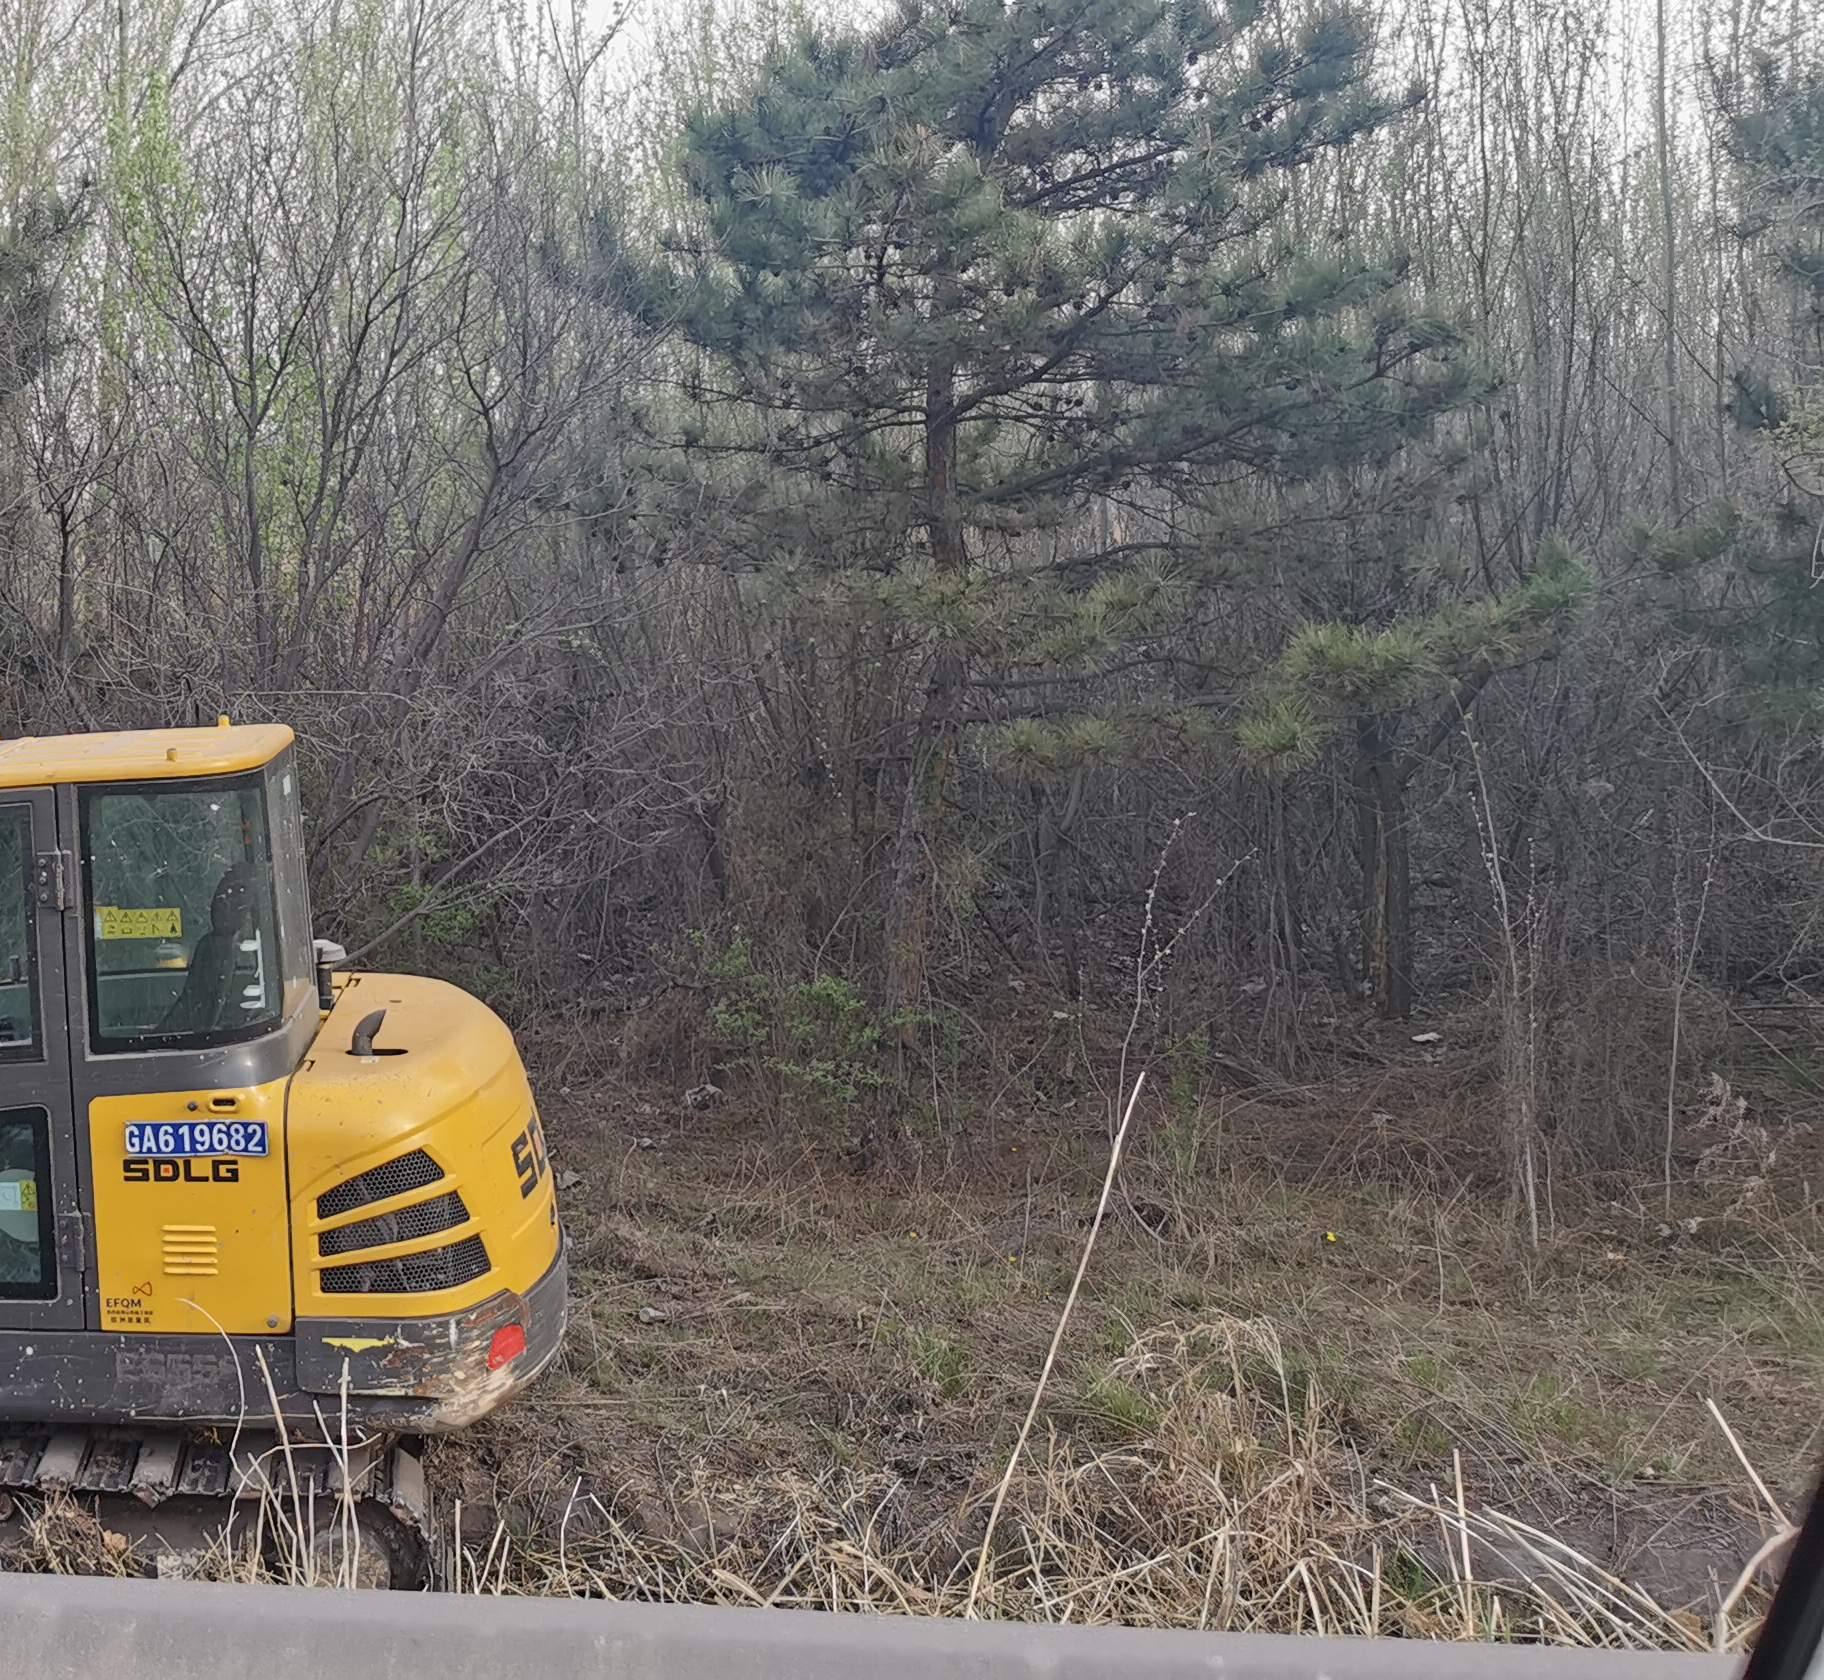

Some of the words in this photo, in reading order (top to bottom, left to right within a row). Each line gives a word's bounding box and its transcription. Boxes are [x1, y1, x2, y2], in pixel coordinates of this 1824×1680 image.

[126, 1124, 263, 1152] GA619682
[123, 1159, 239, 1182] SDLG
[106, 1298, 142, 1308] EFQM
